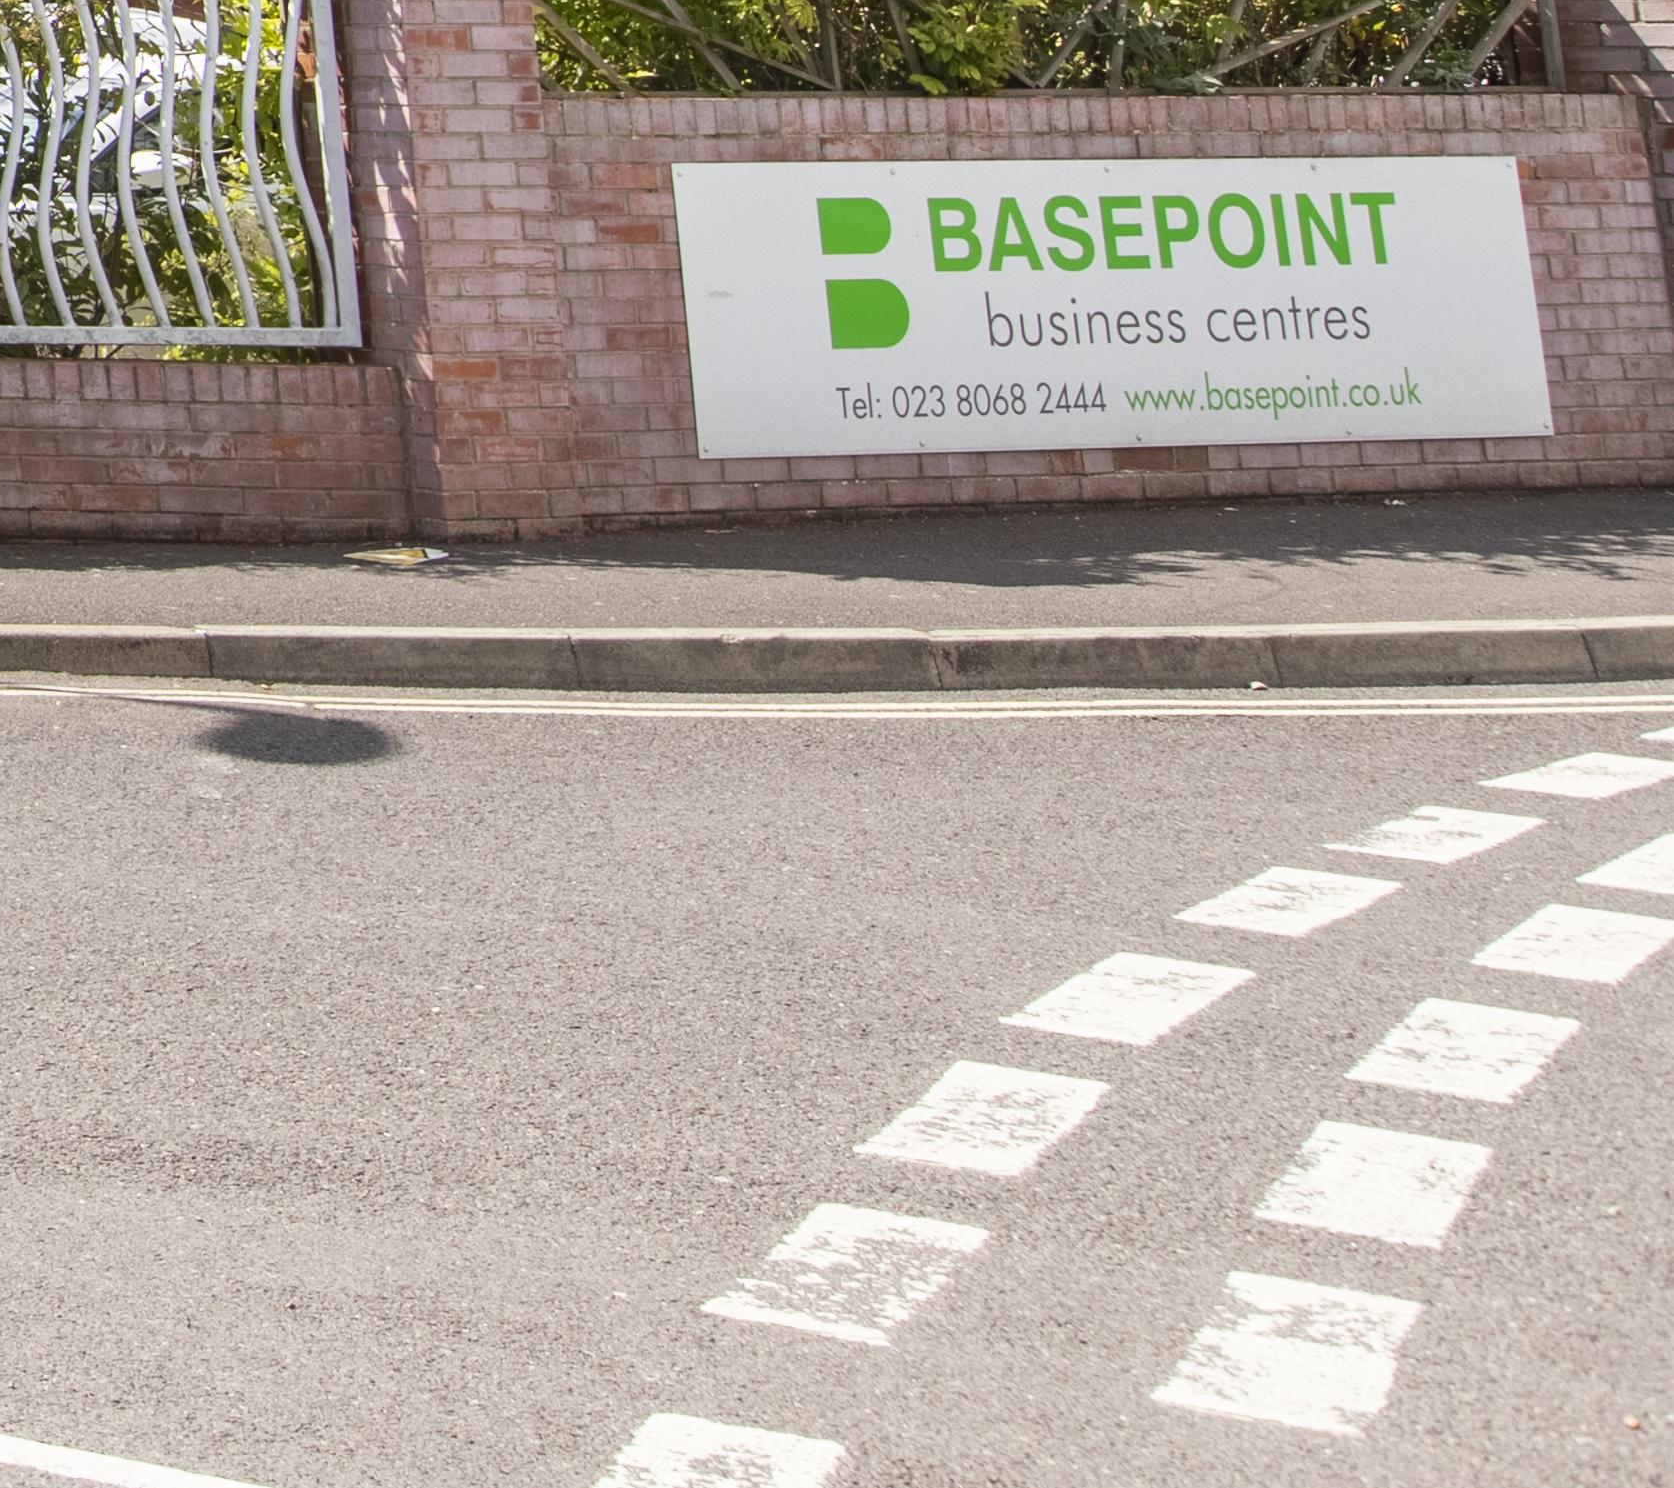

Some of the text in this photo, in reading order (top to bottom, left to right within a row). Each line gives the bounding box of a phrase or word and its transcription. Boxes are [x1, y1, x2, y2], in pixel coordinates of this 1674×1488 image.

[926, 191, 1396, 272] BASEPOINT
[983, 290, 1372, 348] business centres
[835, 366, 1423, 421] Tel: 023 8068 2444 www.basepoint.co.uk
